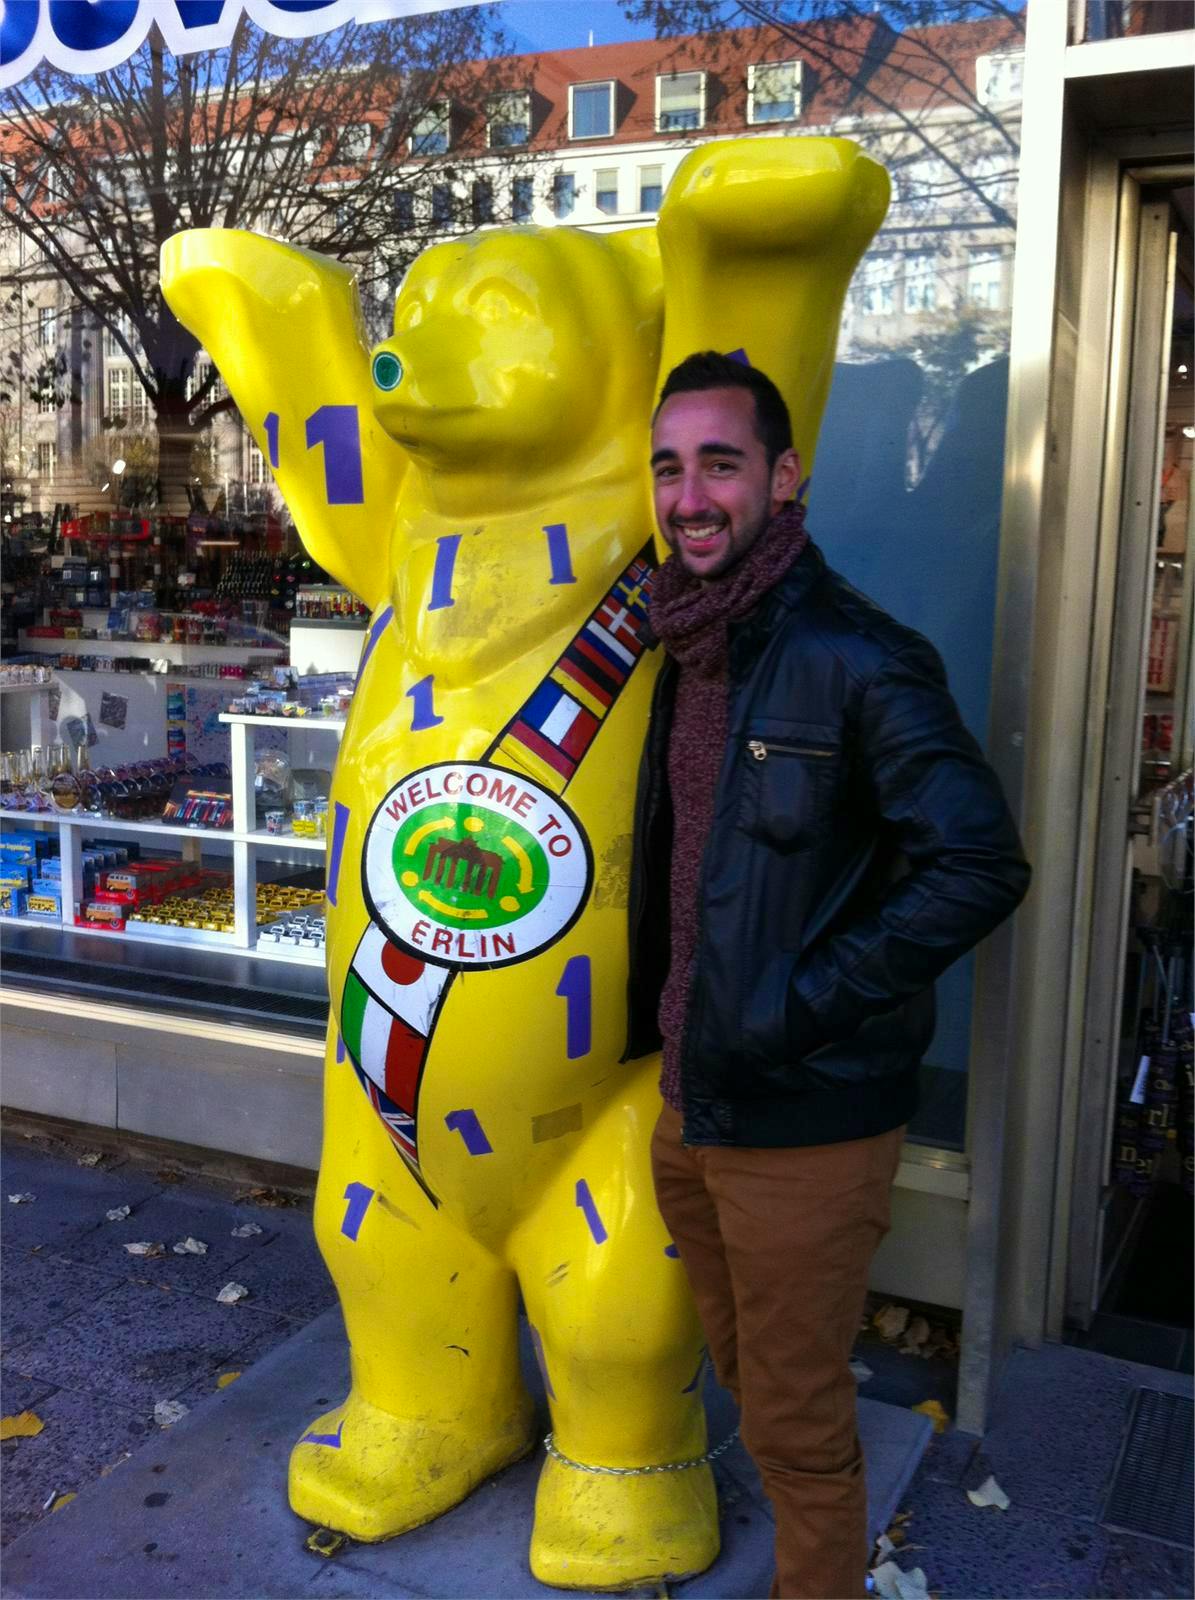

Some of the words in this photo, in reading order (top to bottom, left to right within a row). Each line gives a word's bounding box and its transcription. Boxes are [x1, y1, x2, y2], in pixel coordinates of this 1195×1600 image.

[263, 411, 279, 469] 1
[305, 405, 364, 504] 1
[427, 534, 463, 611] 1
[542, 523, 577, 585] 1
[406, 674, 444, 732] 1
[385, 771, 538, 823] WELCOME
[538, 813, 572, 858] TO
[411, 919, 516, 959] ERLIN
[555, 954, 592, 1060] 1
[444, 1108, 494, 1156] 1
[340, 1181, 375, 1242] 1
[575, 1178, 609, 1245] 1
